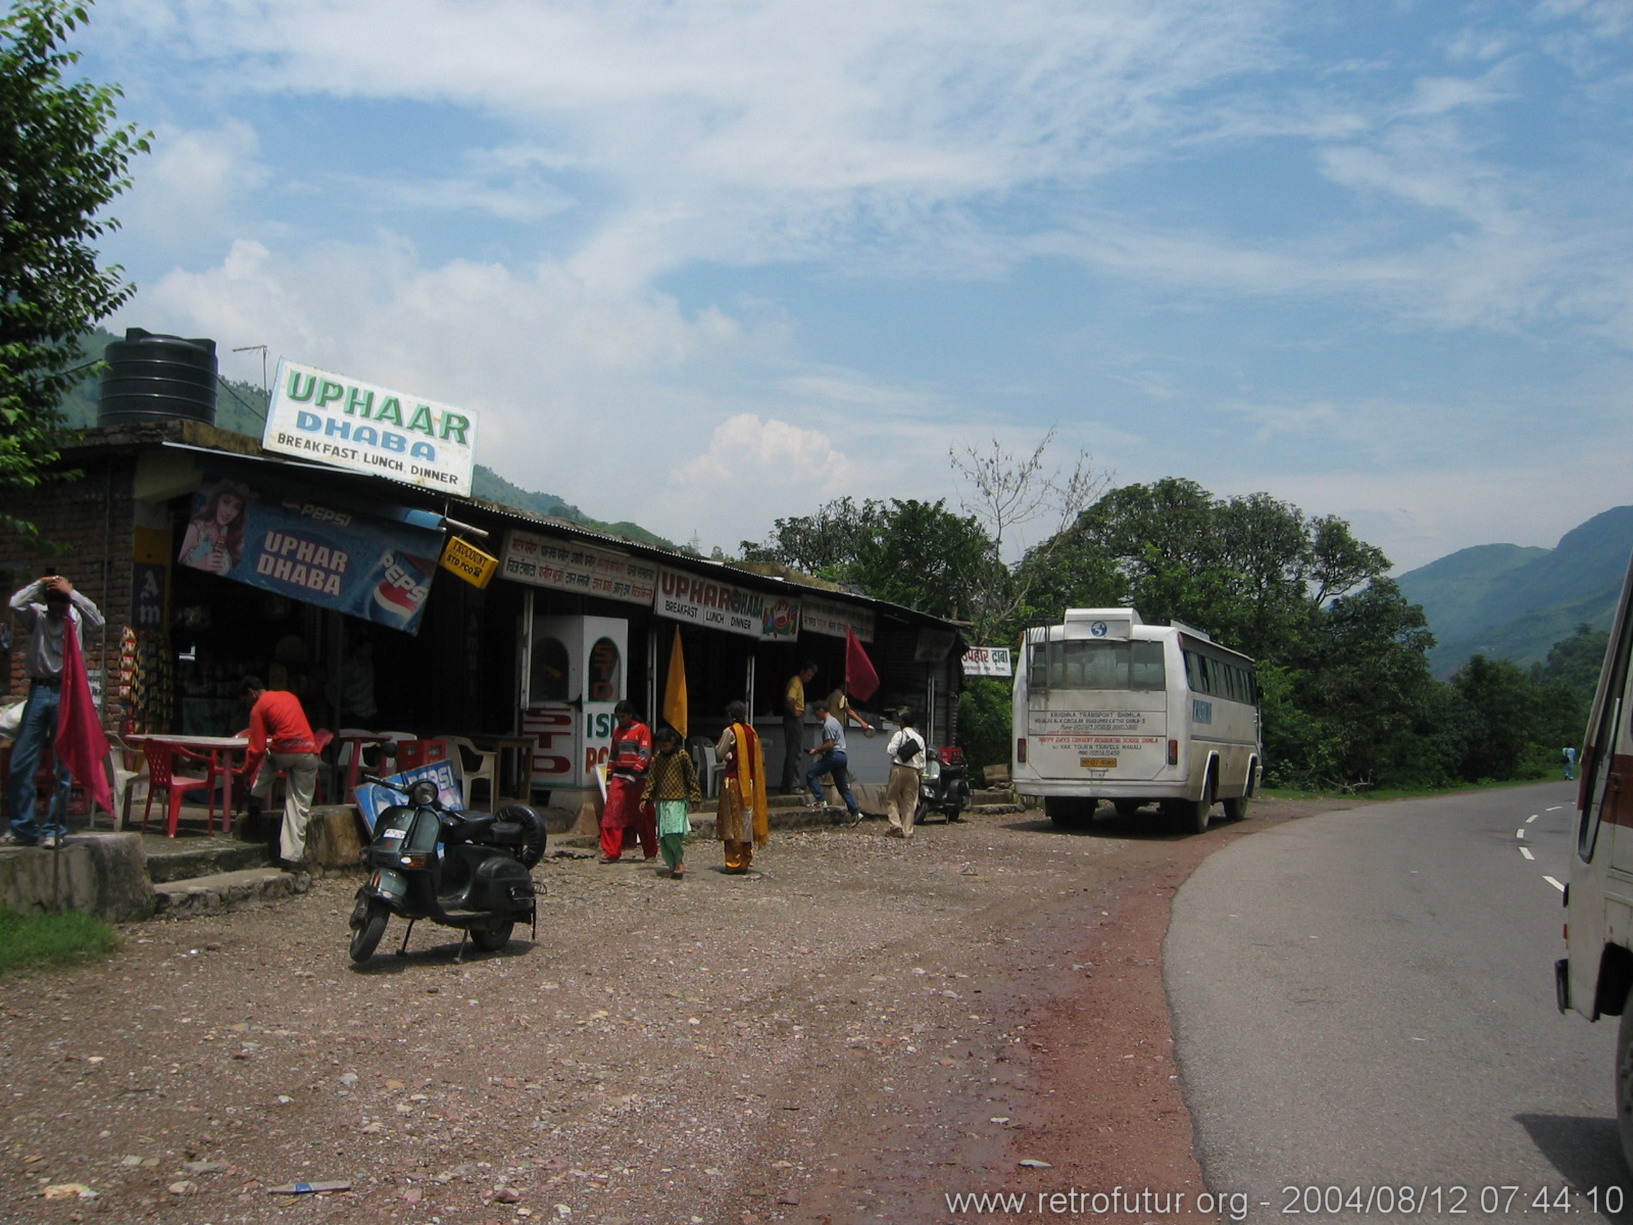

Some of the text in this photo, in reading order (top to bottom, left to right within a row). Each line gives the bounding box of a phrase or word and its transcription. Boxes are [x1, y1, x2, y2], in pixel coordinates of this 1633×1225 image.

[286, 369, 470, 445] UPHAAR
[296, 410, 437, 462] DHABA
[410, 465, 458, 485] DINNER
[301, 503, 353, 528] PEPSI
[264, 530, 348, 573] UPHAR
[446, 554, 474, 574] STD PCO
[256, 553, 341, 597] DHABA
[662, 571, 732, 611] UPHAR
[665, 600, 752, 630] BREAKFAST LUNCH DINNER
[524, 707, 572, 773] STD
